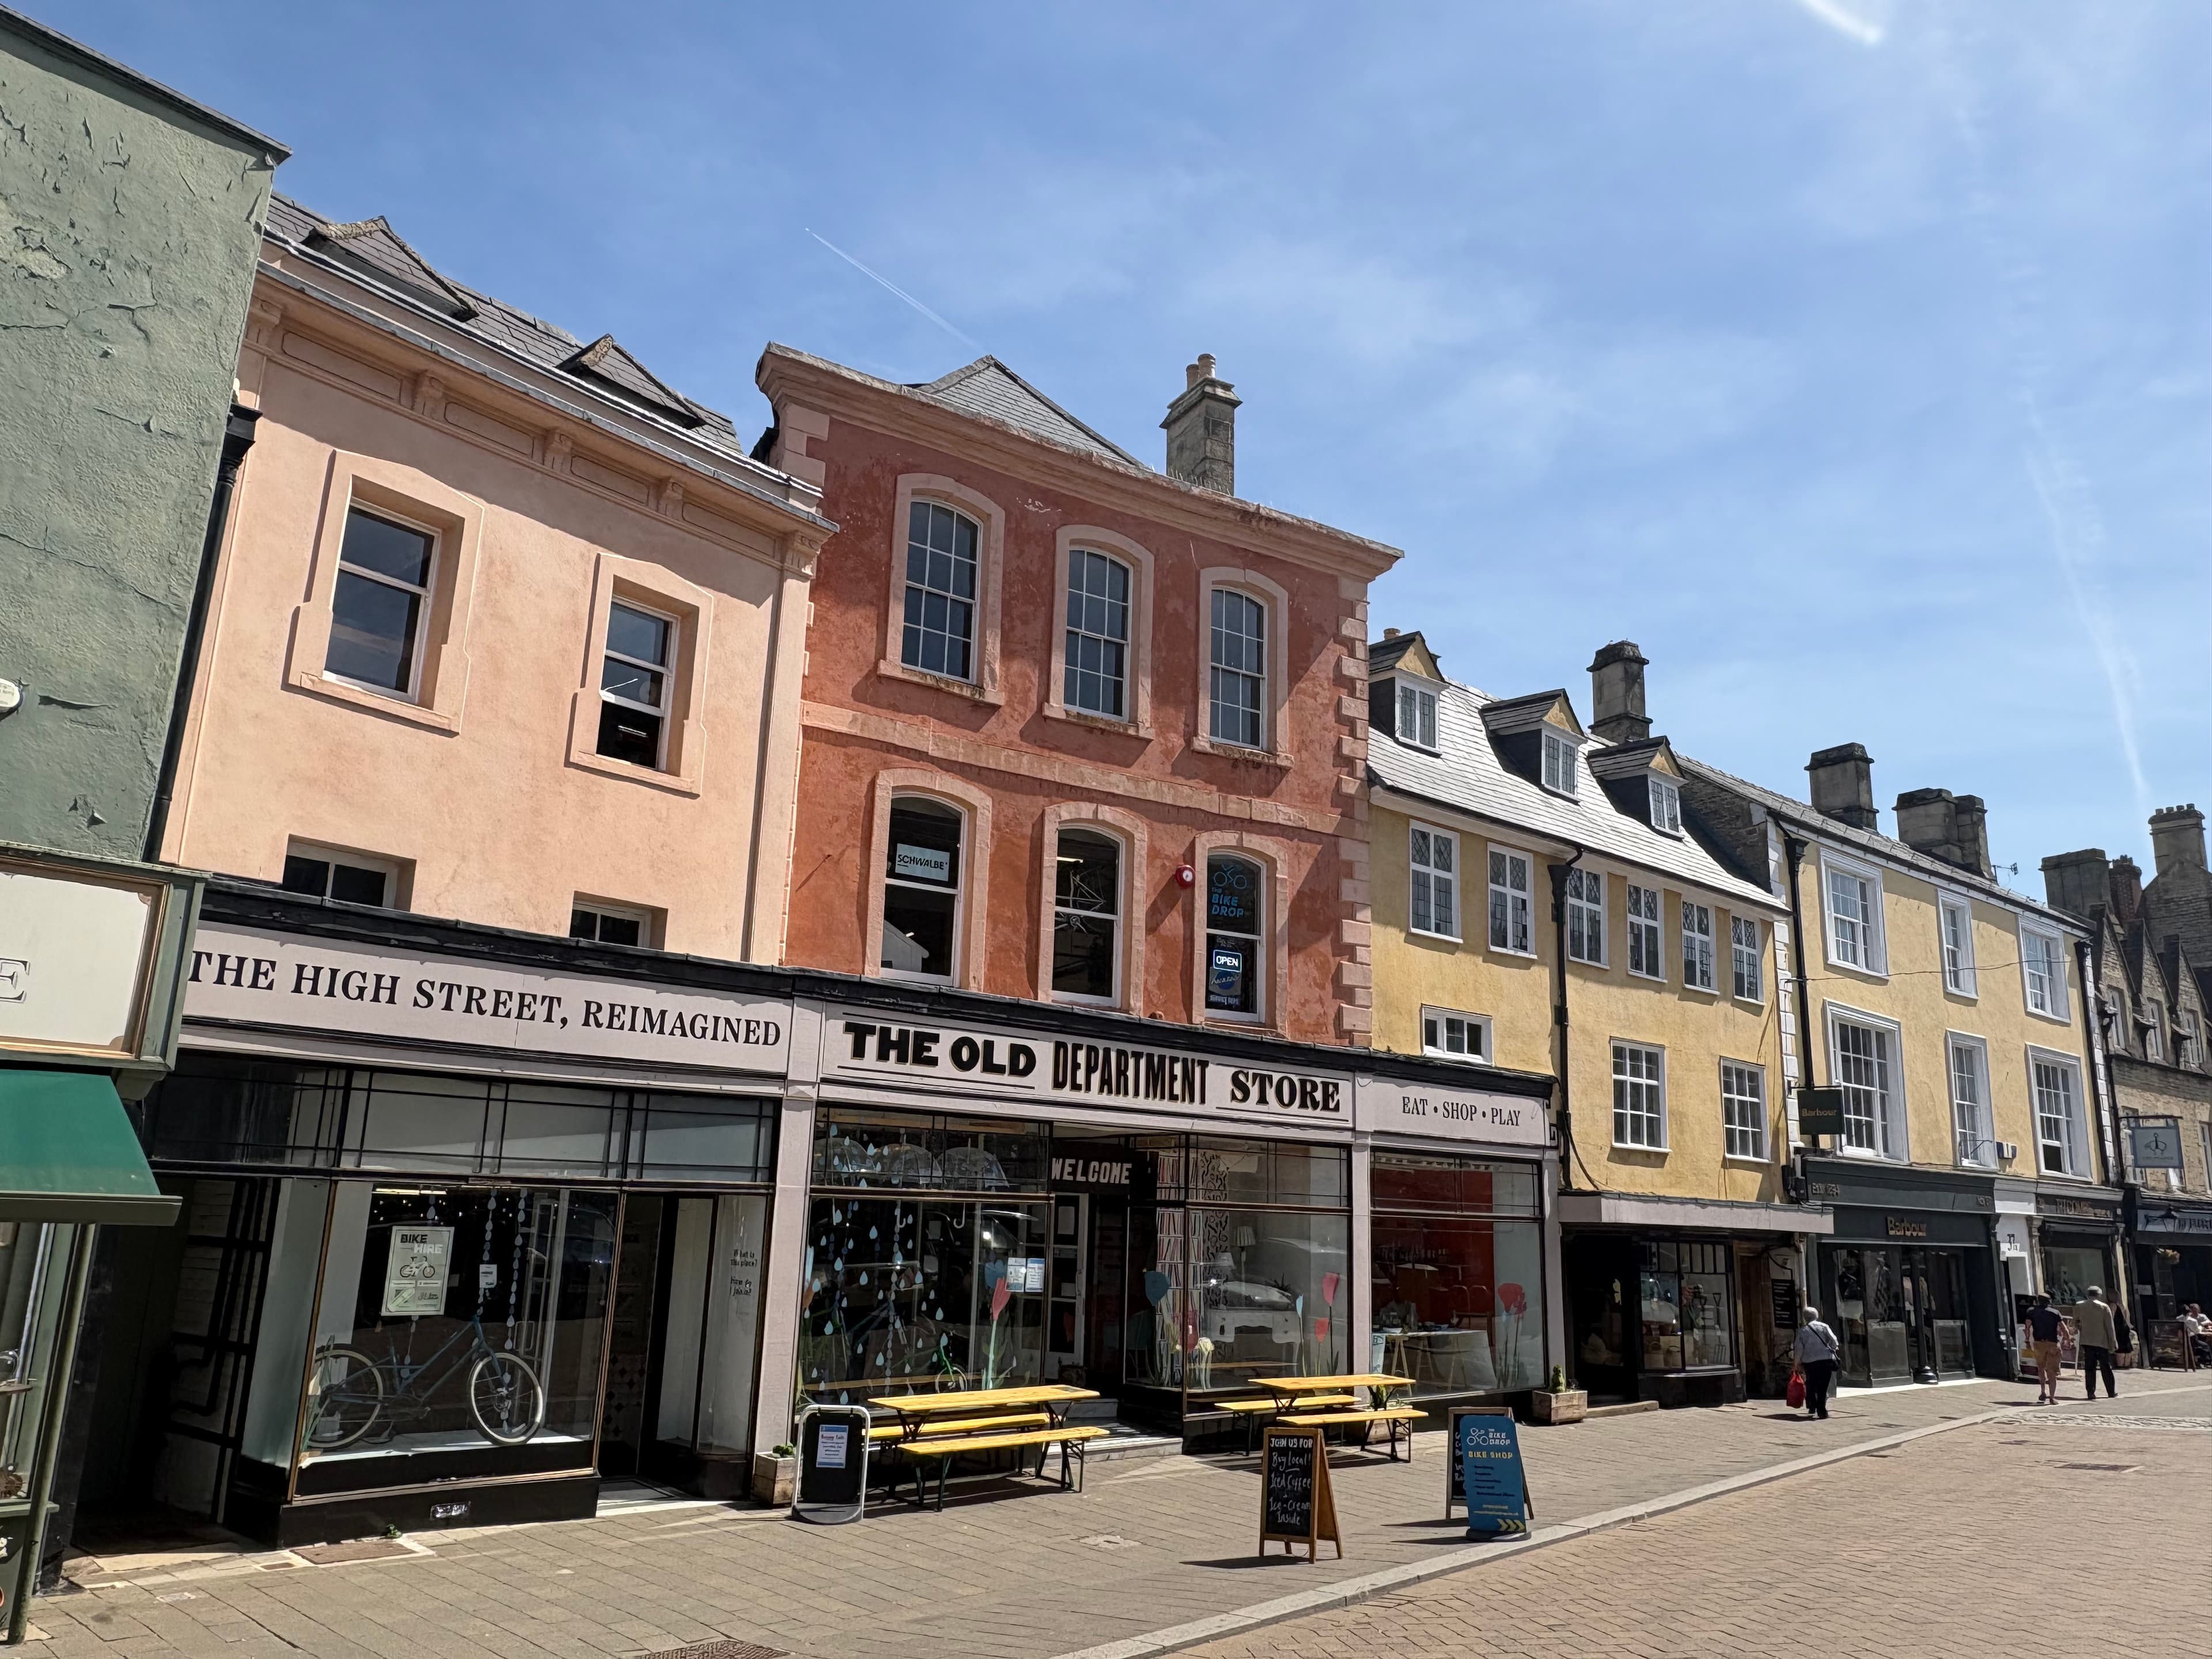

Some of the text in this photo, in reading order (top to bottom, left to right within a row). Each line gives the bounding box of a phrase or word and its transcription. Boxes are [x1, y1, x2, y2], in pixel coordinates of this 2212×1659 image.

[897, 854, 945, 870] SCHWALBE
[1211, 893, 1238, 907] BIKE
[1211, 904, 1244, 917] DROP
[1215, 956, 1238, 967] OPEN
[188, 950, 781, 1047] THE HIGH STREET, REIMAGINED
[843, 1021, 1340, 1112] THE OLD DEPARTMENT STORE
[1402, 1096, 1521, 1126] EAT SHOP PLAY
[1051, 1158, 1132, 1184] WELCOME
[1886, 1216, 1927, 1236] Barbour
[400, 1234, 428, 1243] BIKE
[414, 1243, 442, 1253] HIRE
[1289, 1438, 1298, 1448] US
[1270, 1471, 1286, 1489] Iced
[1277, 1510, 1301, 1525] Inside
